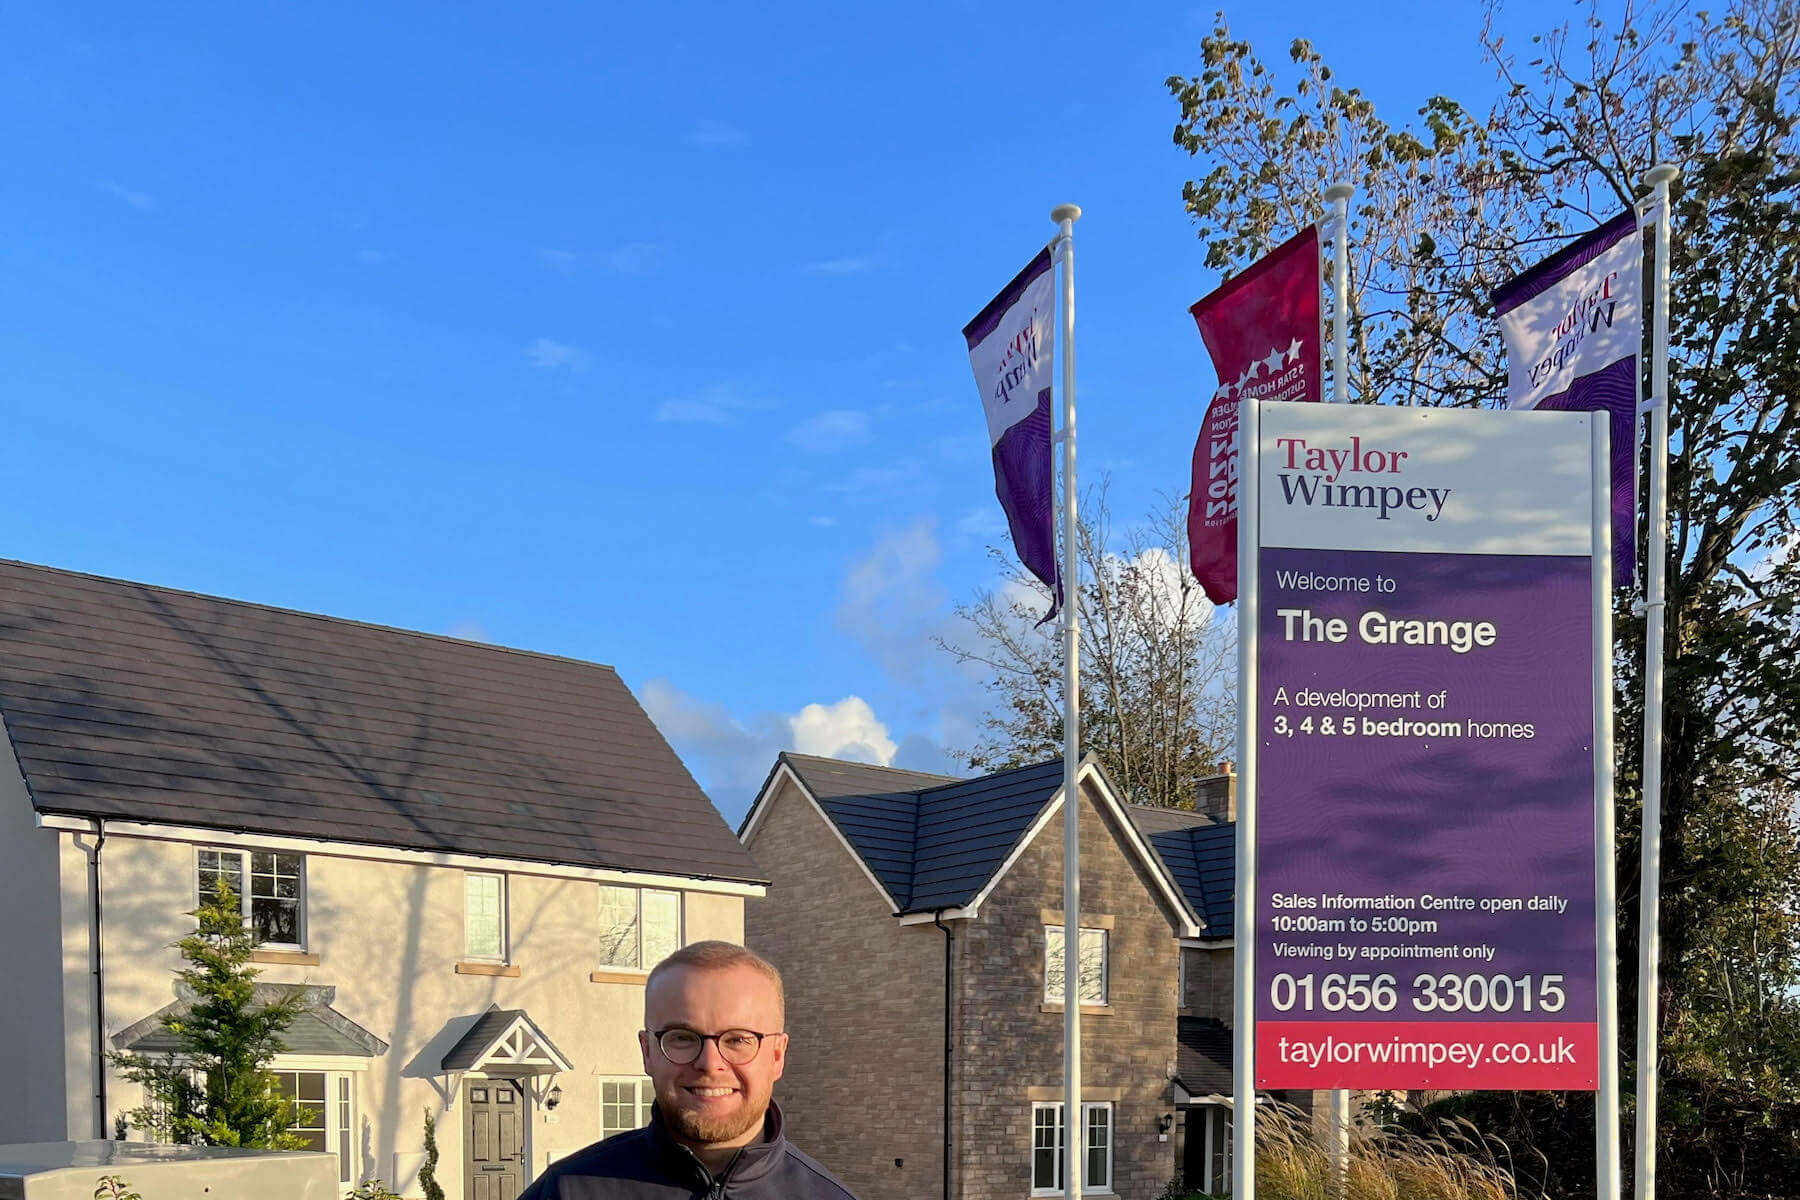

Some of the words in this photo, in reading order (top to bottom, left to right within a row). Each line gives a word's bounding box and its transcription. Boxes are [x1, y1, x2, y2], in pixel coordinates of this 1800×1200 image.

[1277, 436, 1408, 483] Taylor
[1278, 474, 1451, 522] Wimpey
[1276, 570, 1370, 593] Welcome
[1376, 573, 1397, 594] to
[1276, 609, 1348, 643] The
[1358, 611, 1497, 654] Grange
[1273, 687, 1289, 707] A
[1295, 689, 1421, 712] development
[1427, 690, 1447, 709] of
[1273, 716, 1293, 738] 3,
[1300, 717, 1314, 736] 4
[1320, 717, 1340, 736] &
[1342, 717, 1356, 736] 5
[1362, 718, 1462, 738] bedroom
[1467, 719, 1535, 739] homes
[1271, 893, 1317, 910] Sales
[1321, 894, 1416, 911] Information
[1420, 894, 1475, 911] Centre
[1479, 898, 1522, 914] open
[1526, 895, 1568, 914] daily
[1272, 917, 1346, 934] 10:00am
[1349, 918, 1368, 934] to
[1371, 917, 1438, 936] 5:00pm
[1273, 942, 1334, 961] Viewing
[1338, 943, 1357, 961] by
[1360, 944, 1459, 962] appointment
[1463, 943, 1496, 961] only
[1270, 973, 1398, 1012] 01656
[1411, 974, 1566, 1013] 330015
[1279, 1036, 1576, 1069] taylorwimpey.co.uk
